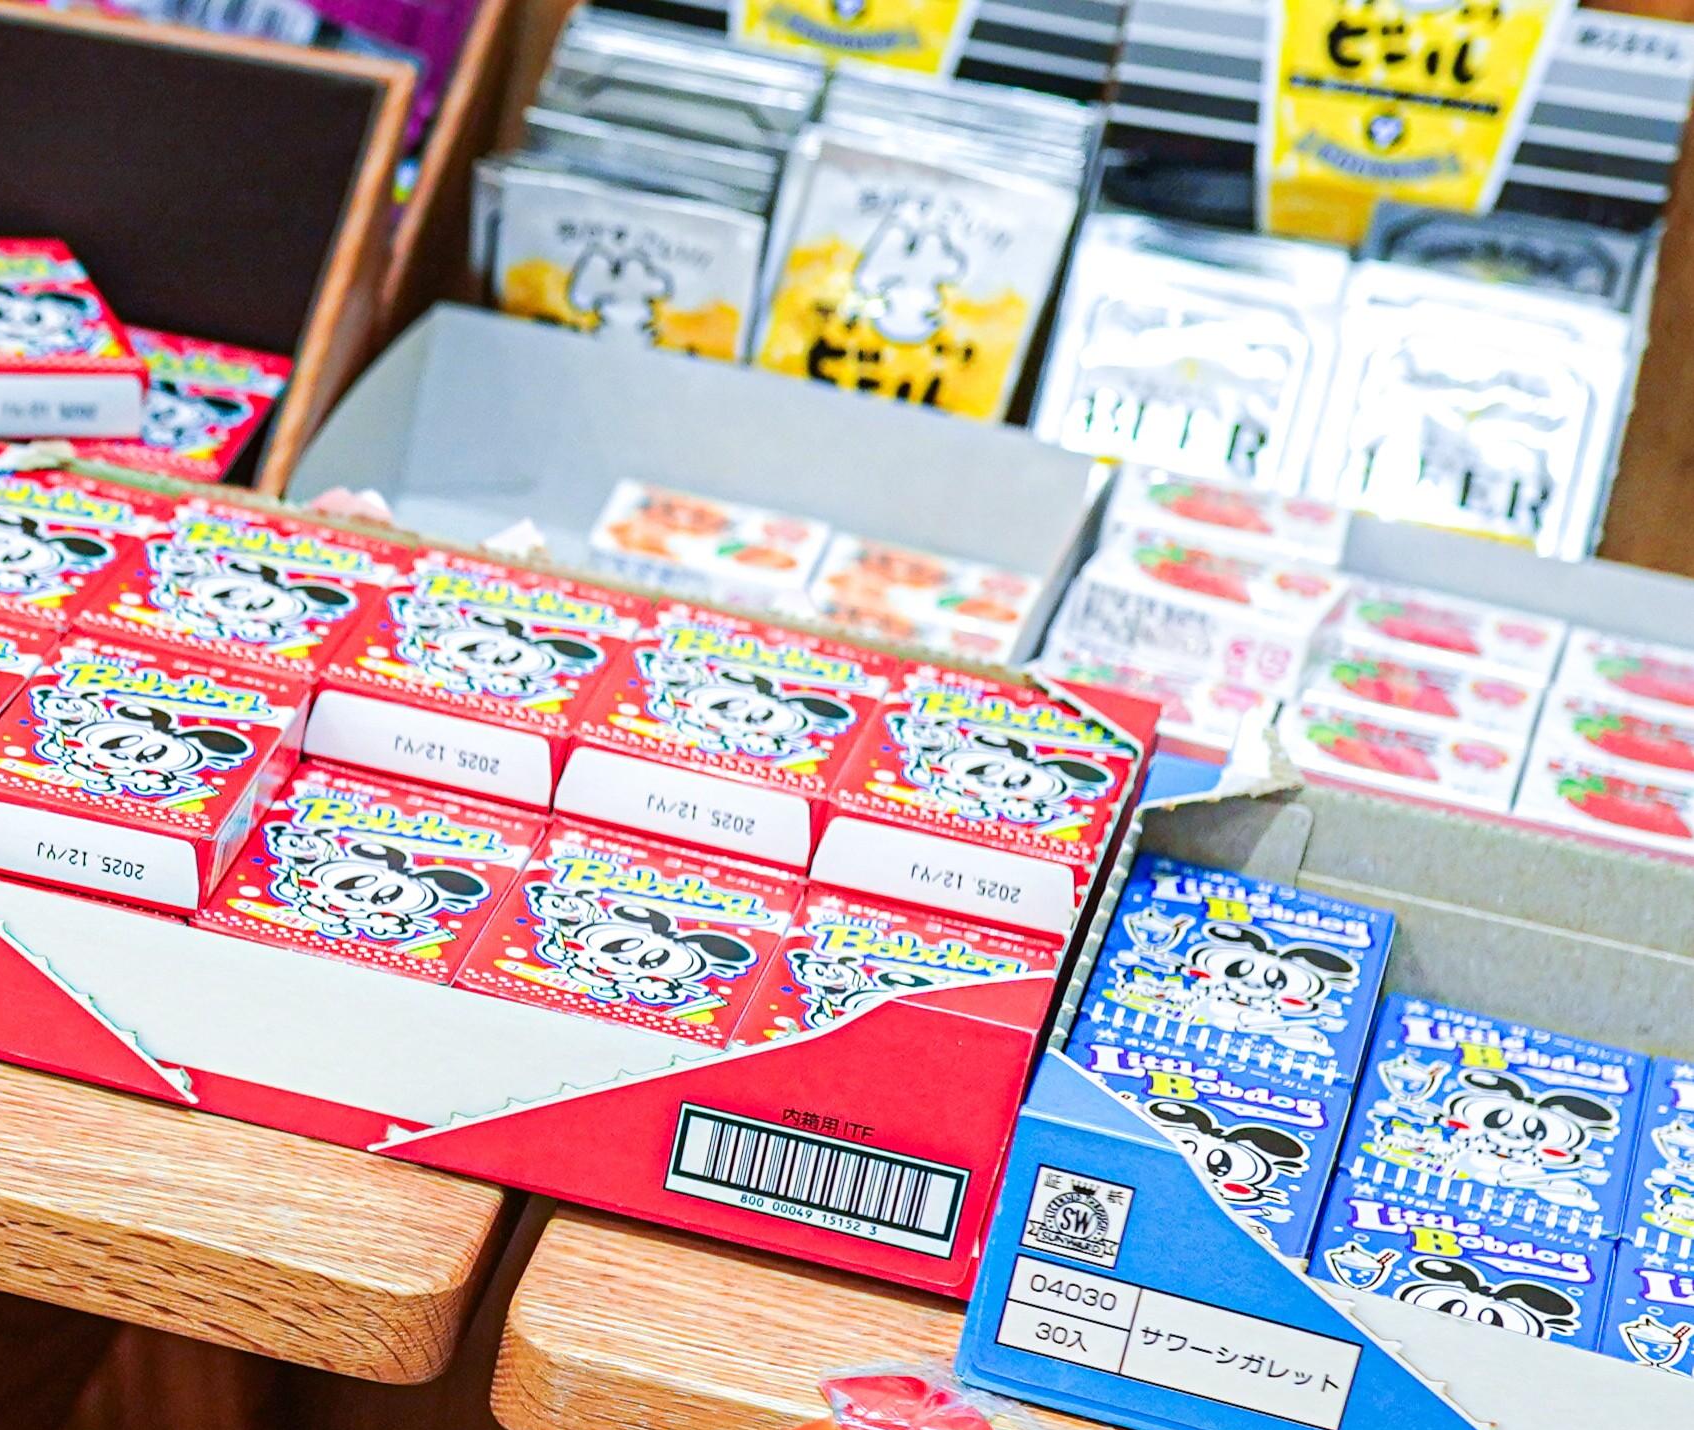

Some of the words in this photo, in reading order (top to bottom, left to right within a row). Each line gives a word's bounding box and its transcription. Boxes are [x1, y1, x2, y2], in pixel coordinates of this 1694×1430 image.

[63, 662, 267, 713] Bobdog
[299, 797, 503, 853] Bobdog
[558, 855, 763, 918] Bobdog
[1089, 1044, 1221, 1081] Little
[1147, 1070, 1325, 1119] Bobdog
[782, 1108, 839, 1134] 内箱用
[842, 1122, 876, 1140] ITF
[739, 1193, 765, 1208] 800
[771, 1200, 814, 1220] 00049
[821, 1213, 861, 1233] 15152
[868, 1224, 878, 1236] 3
[1060, 1206, 1089, 1232] SW
[1348, 1199, 1484, 1236] Little
[1409, 1225, 1593, 1272] Bobdog
[1030, 1273, 1117, 1311] 04030
[1035, 1322, 1088, 1352] 30入
[1141, 1326, 1340, 1392] サワーシガレット
